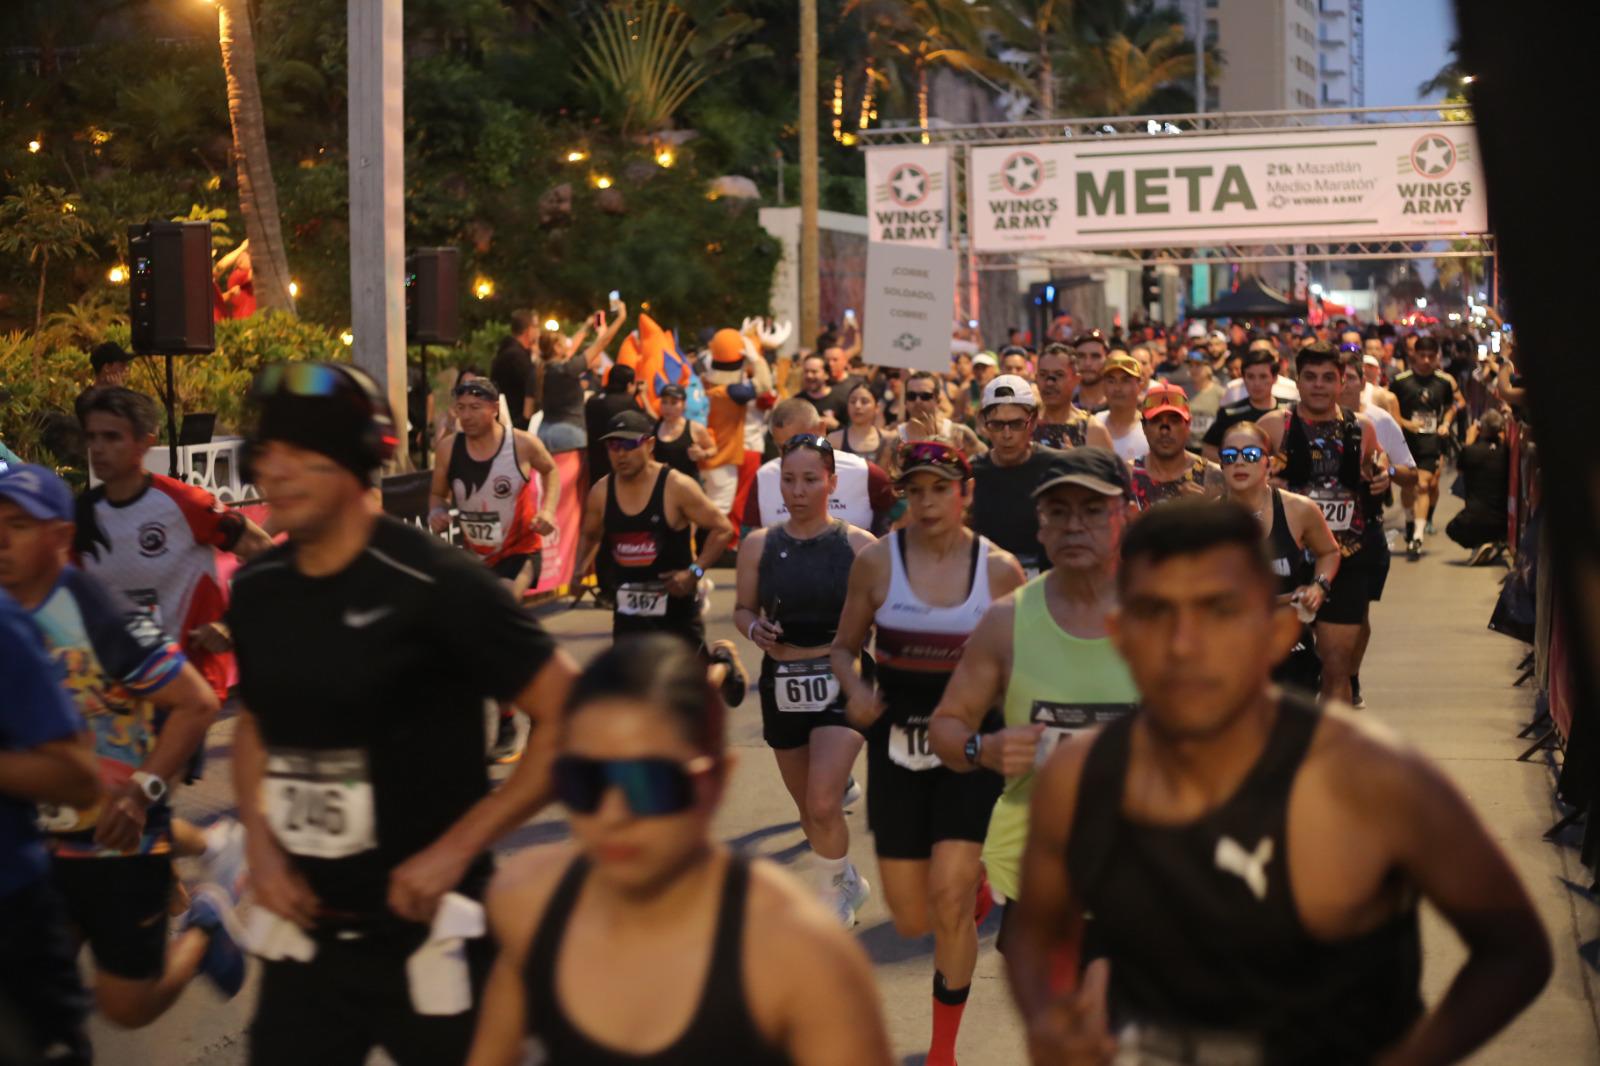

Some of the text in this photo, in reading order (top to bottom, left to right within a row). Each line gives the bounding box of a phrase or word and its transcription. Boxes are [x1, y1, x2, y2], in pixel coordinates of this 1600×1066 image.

[1266, 163, 1293, 176] 21k
[1076, 165, 1258, 217] META
[1266, 179, 1312, 193] Medio
[1402, 199, 1466, 215] ARMY
[994, 214, 1052, 230] ARMY
[882, 226, 938, 241] ARMY
[467, 523, 494, 541] 372
[785, 677, 828, 703] 610
